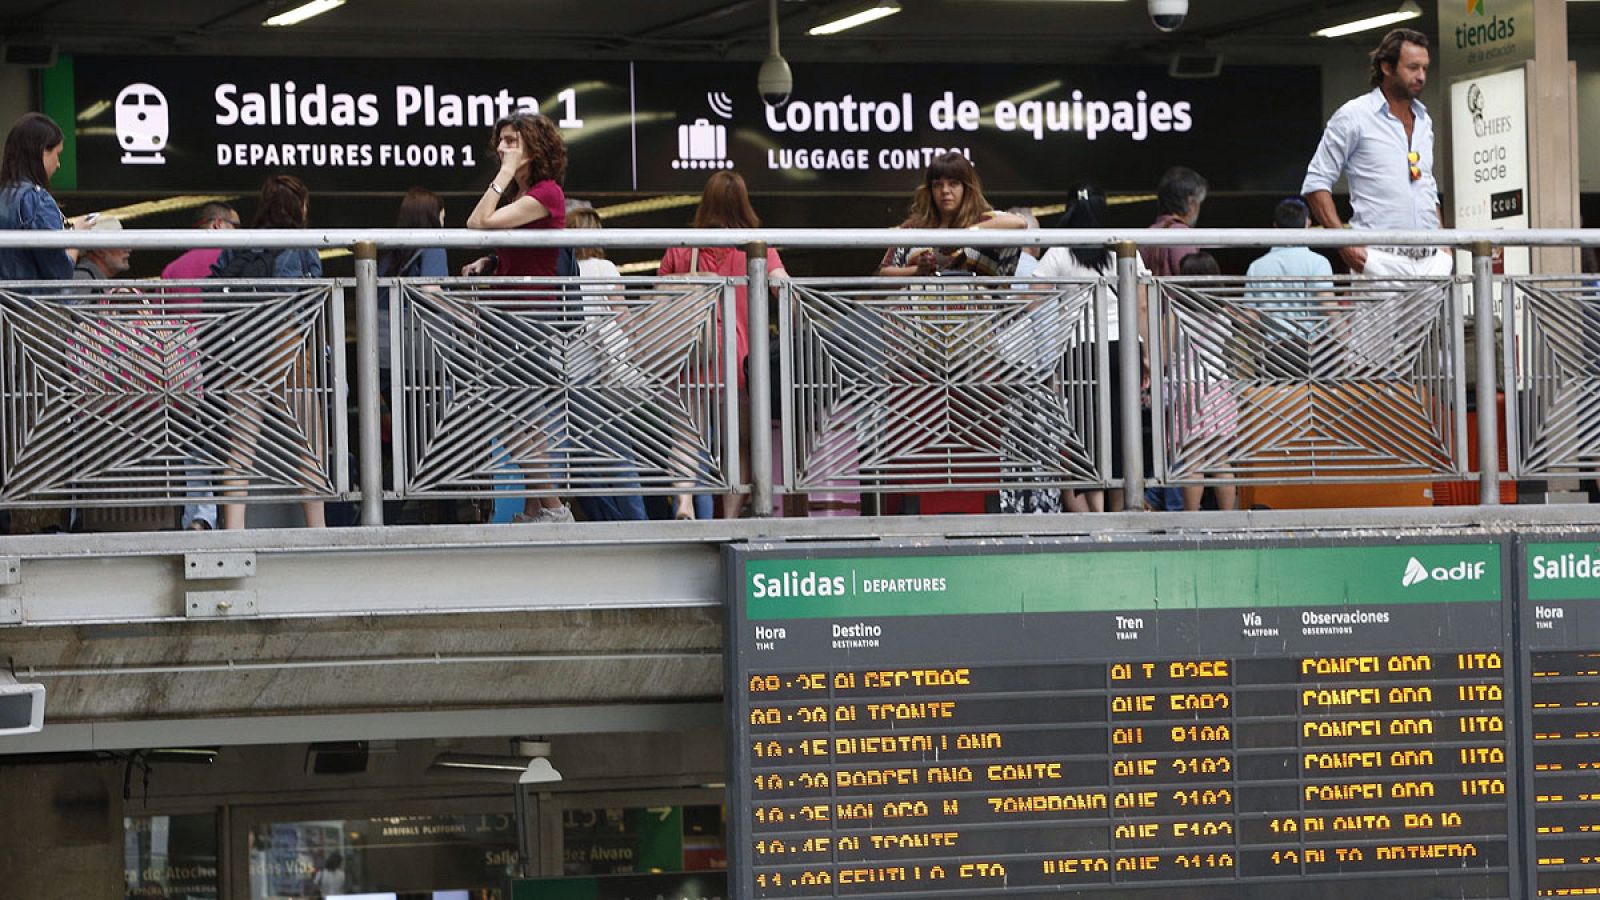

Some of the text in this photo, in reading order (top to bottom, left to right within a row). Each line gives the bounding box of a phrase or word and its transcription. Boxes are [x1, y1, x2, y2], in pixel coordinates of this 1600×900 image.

[1456, 15, 1515, 49] tiendas
[216, 81, 584, 129] Salidas Planta 1
[765, 91, 1191, 140] Control de equipajes
[218, 144, 475, 165] DEPARTURES FLOOR 1
[769, 150, 868, 168] LUGGAGE
[1431, 559, 1486, 581] adif
[1533, 552, 1600, 579] Salida
[754, 571, 945, 597] Salidas DEPARTURES
[1242, 611, 1262, 626] Vía
[1302, 608, 1390, 625] Observaciones
[1535, 605, 1564, 619] Hora
[833, 623, 881, 636] Destino
[1115, 615, 1144, 629] Tren
[756, 627, 785, 639] Hora
[1302, 626, 1353, 636] OBSERVATIONS
[756, 642, 775, 650] TIME
[832, 639, 880, 649] DESTINATION
[422, 824, 466, 834] PLATFORMS
[485, 848, 520, 865] Salid
[590, 845, 633, 862] Álvaro
